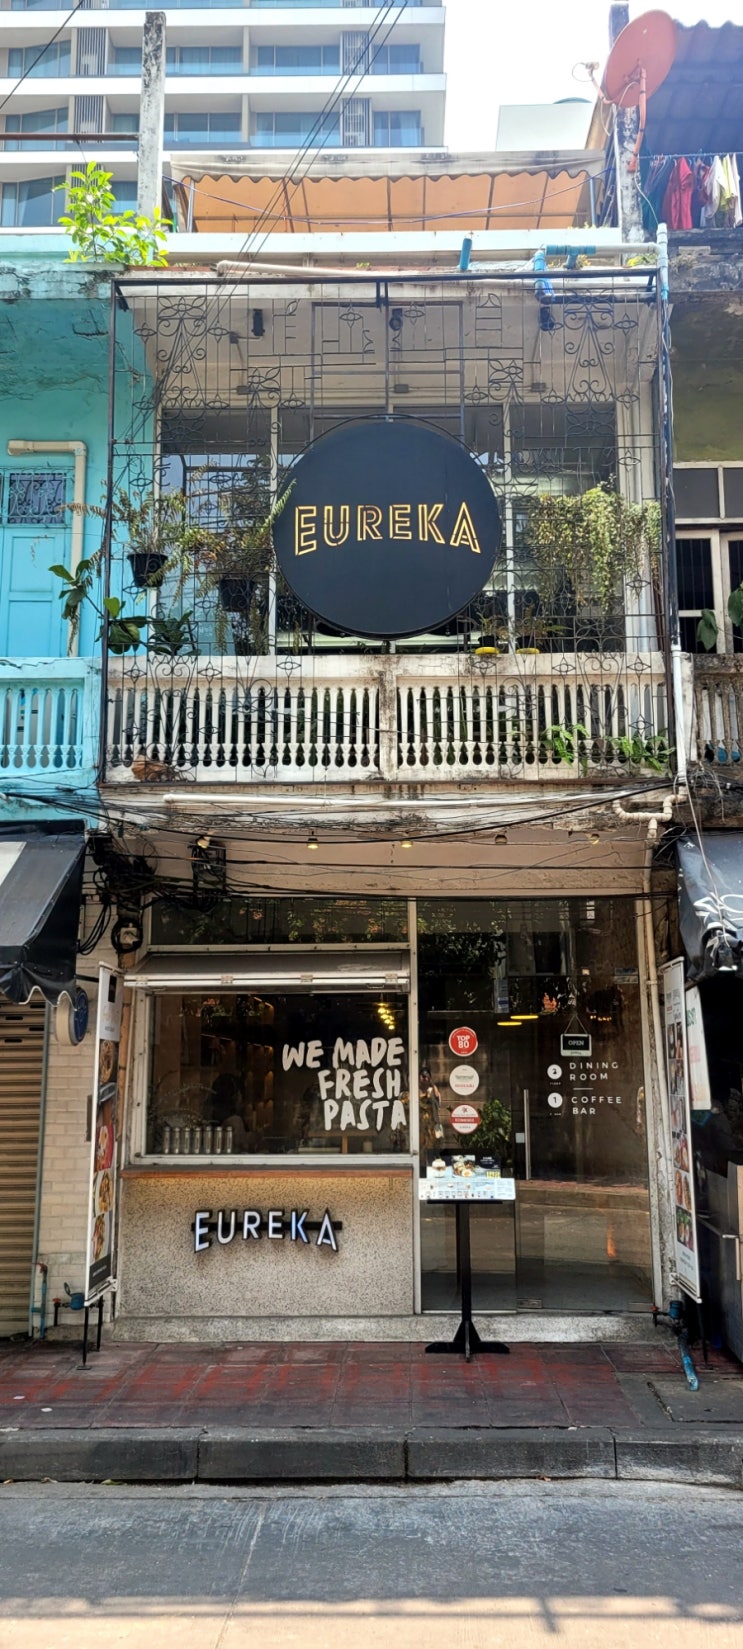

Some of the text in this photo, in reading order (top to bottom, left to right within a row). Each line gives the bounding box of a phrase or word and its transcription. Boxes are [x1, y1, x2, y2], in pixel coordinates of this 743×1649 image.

[294, 501, 482, 556] EUREKA
[282, 1037, 405, 1071] WE MADE
[457, 1041, 470, 1049] 80
[569, 1062, 619, 1070] DINING
[317, 1067, 401, 1100] FRESH
[569, 1073, 608, 1081] ROOM
[571, 1096, 622, 1104] COFFEE
[323, 1099, 407, 1131] PASTA
[572, 1107, 596, 1115] BAR
[194, 1209, 338, 1252] EUREKA
